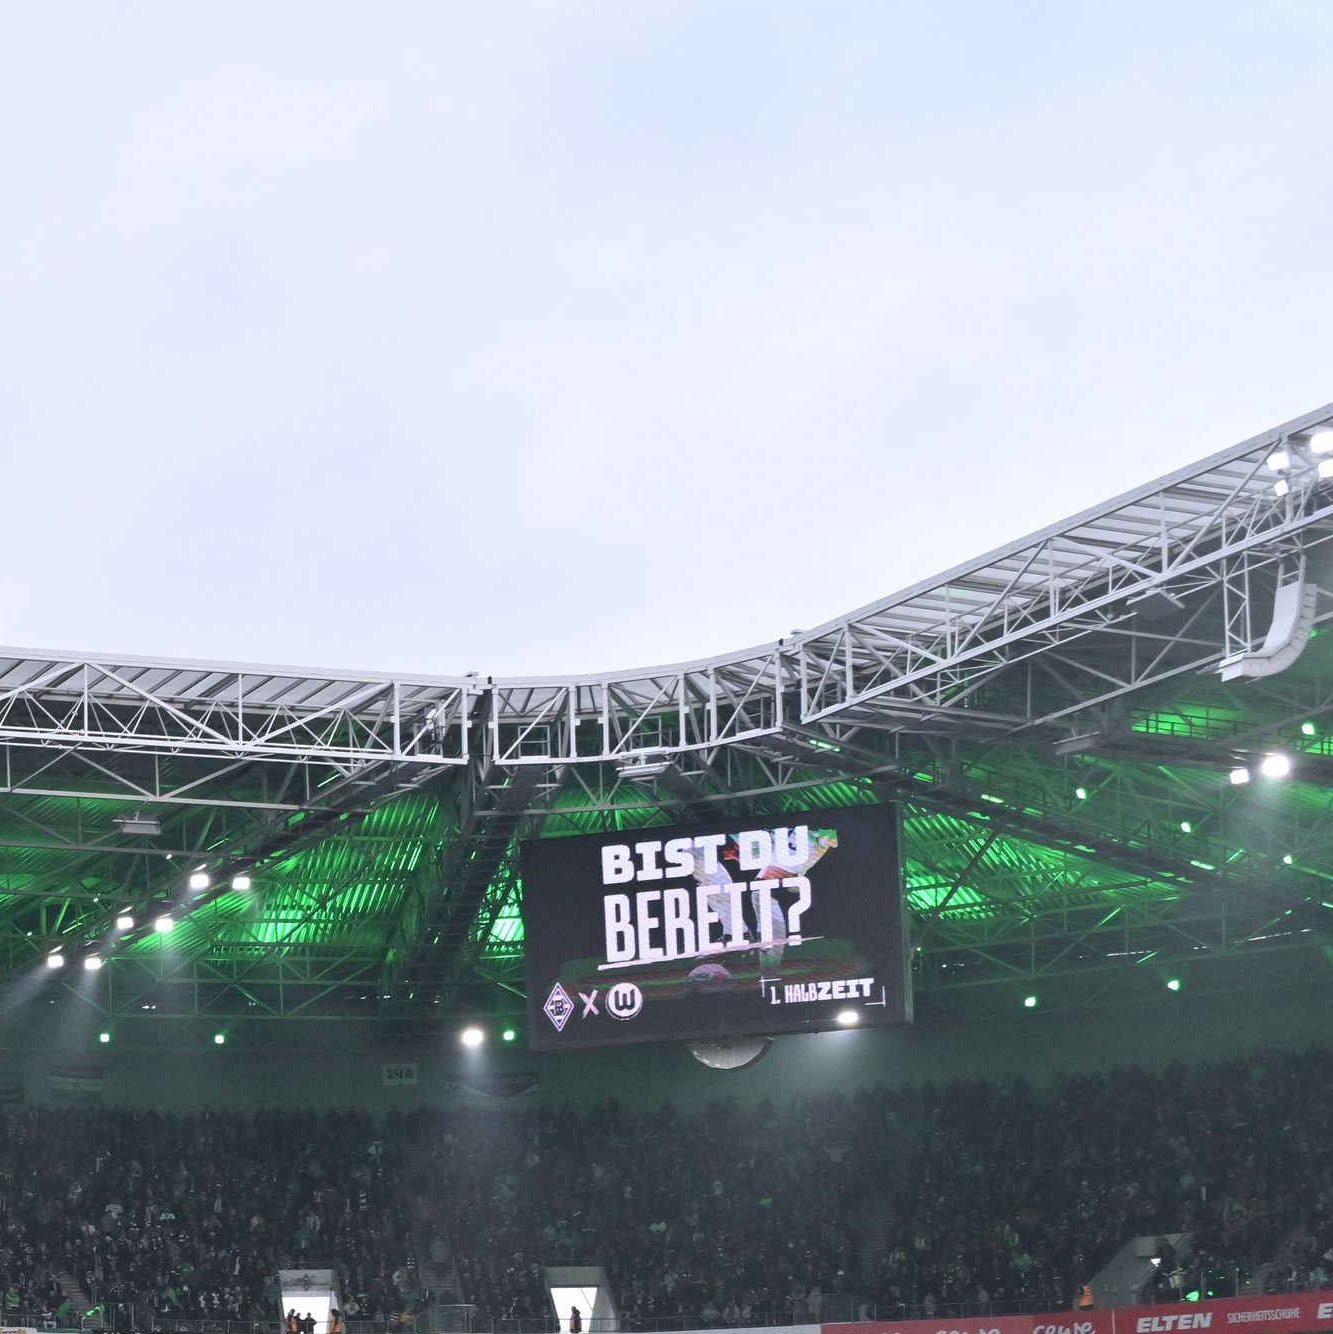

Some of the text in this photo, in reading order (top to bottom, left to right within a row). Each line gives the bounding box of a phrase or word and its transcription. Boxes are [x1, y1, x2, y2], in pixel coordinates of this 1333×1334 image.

[601, 825, 809, 885] BIST DU
[603, 876, 812, 963] BEREIT?
[785, 978, 874, 1003] HALBZEIT
[386, 1069, 414, 1080] 14A
[1136, 1312, 1212, 1334] ELTEN
[1226, 1307, 1301, 1324] SICHERHEITSSCHUHE
